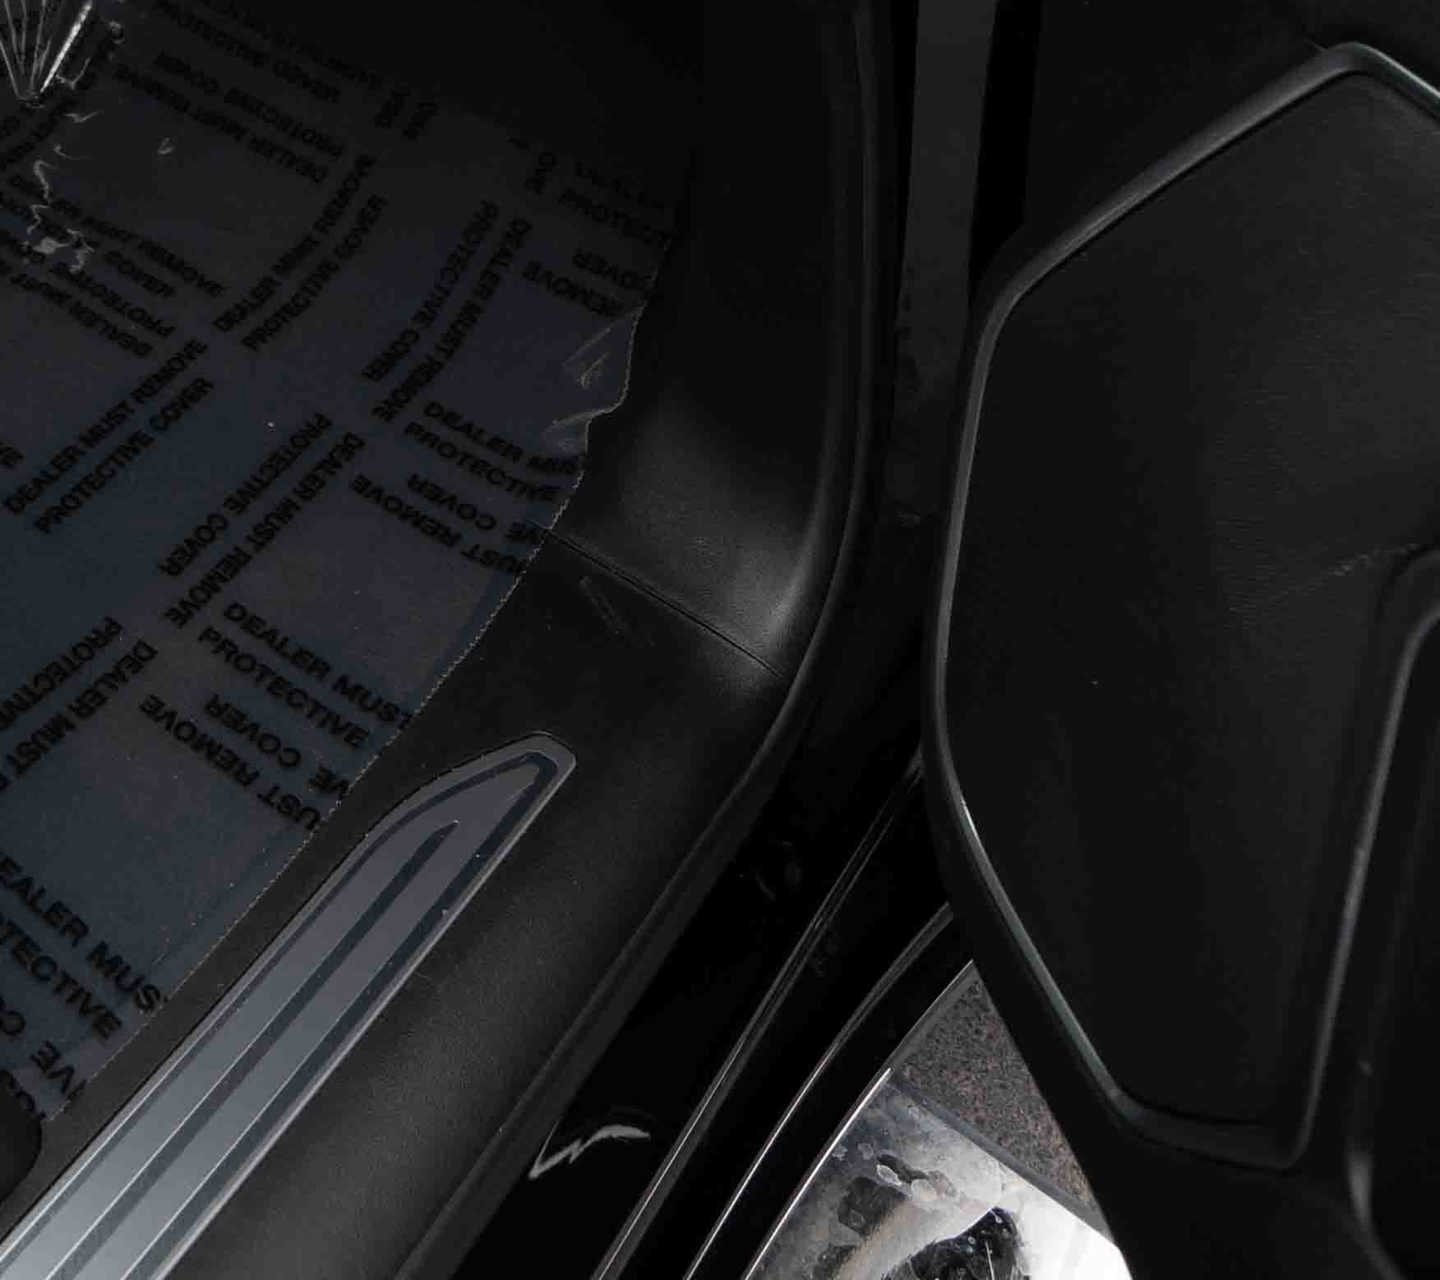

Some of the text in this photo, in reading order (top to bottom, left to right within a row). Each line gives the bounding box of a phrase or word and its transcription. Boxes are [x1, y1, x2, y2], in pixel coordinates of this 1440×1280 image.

[2, 443, 87, 516] DEALER
[78, 399, 135, 450] MUST
[131, 339, 209, 406] REMOVE
[33, 429, 155, 534] PROTECTIVE
[148, 376, 214, 435] COVER
[157, 411, 334, 579] PROTECTIVE COVER
[162, 431, 367, 631] DEALER MUST REMOVE
[348, 473, 464, 548] REMOVE
[406, 472, 499, 533] COVER
[68, 639, 160, 721] DEALER
[223, 601, 332, 682] DEALER
[197, 626, 371, 752] PROTECTIVE
[6, 712, 77, 778] MUST
[137, 693, 261, 788] REMOVE
[202, 693, 303, 769] COVER
[256, 785, 320, 831] UST
[86, 940, 167, 1015] MUS
